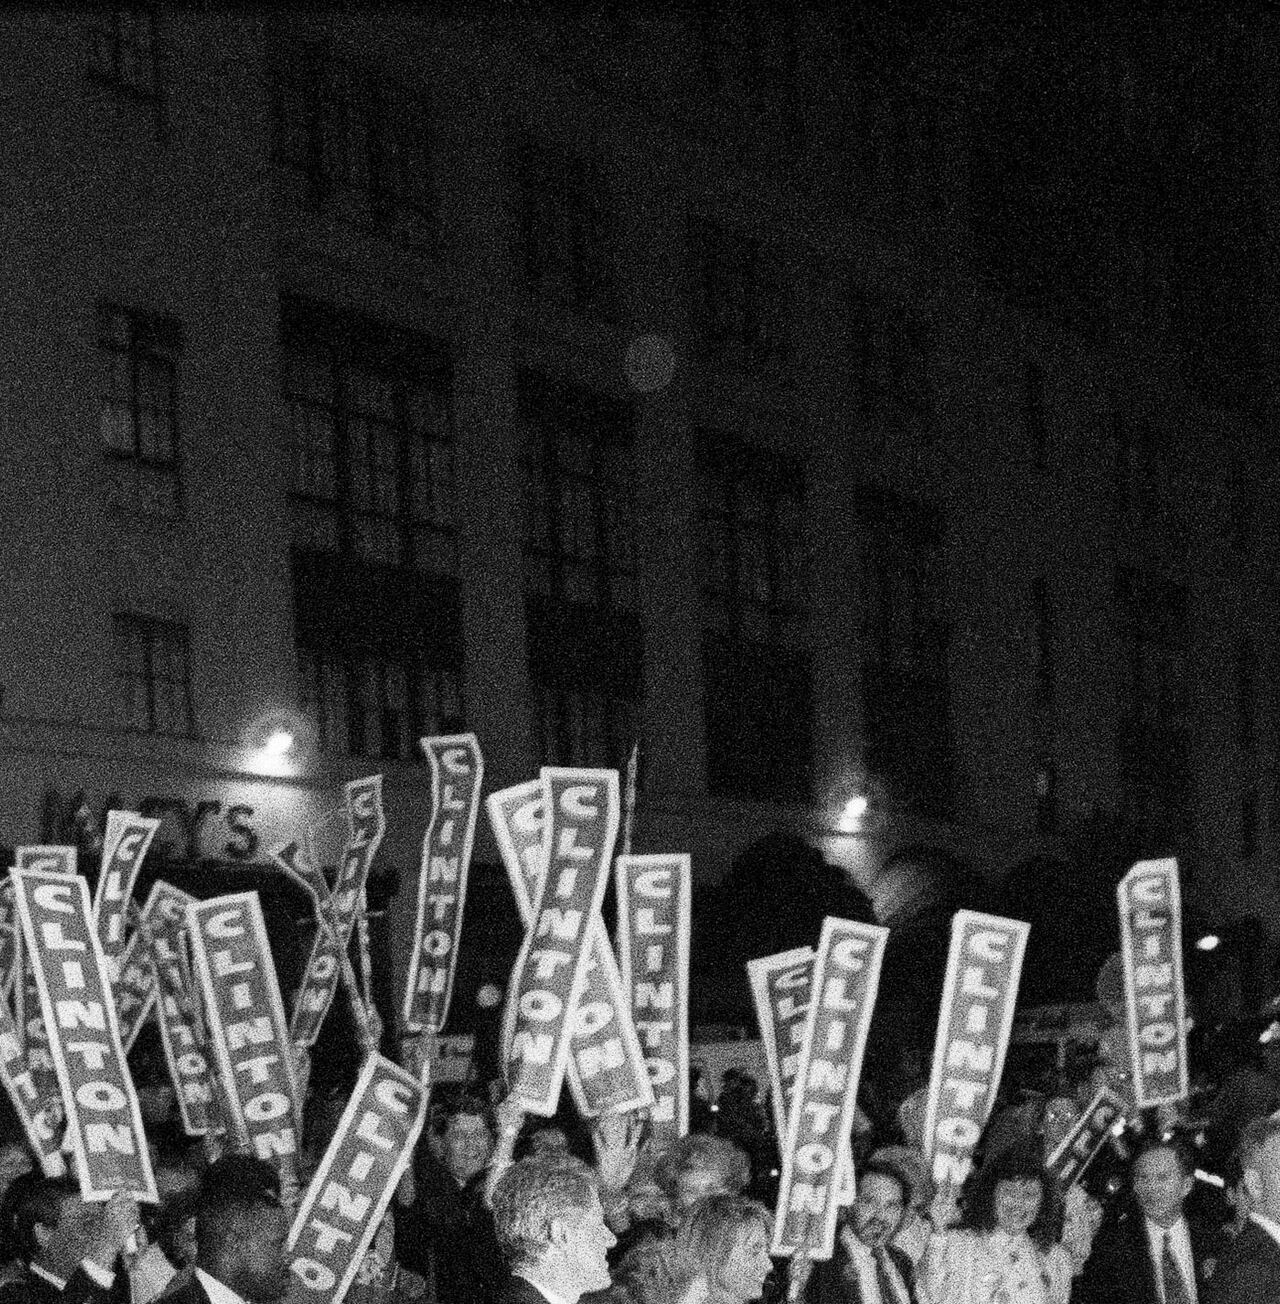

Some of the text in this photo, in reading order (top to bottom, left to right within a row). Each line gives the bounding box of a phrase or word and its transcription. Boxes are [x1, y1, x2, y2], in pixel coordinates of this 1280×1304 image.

[419, 748, 471, 994] CLINTON
[511, 786, 600, 1065] CLINTON
[633, 870, 676, 1122] CLINTON
[1130, 877, 1177, 1077] CLINTON
[32, 884, 138, 1156] CLINTON
[206, 909, 298, 1160] CLINTON
[789, 937, 870, 1215] CLINTON
[931, 931, 1010, 1184] CLINTON
